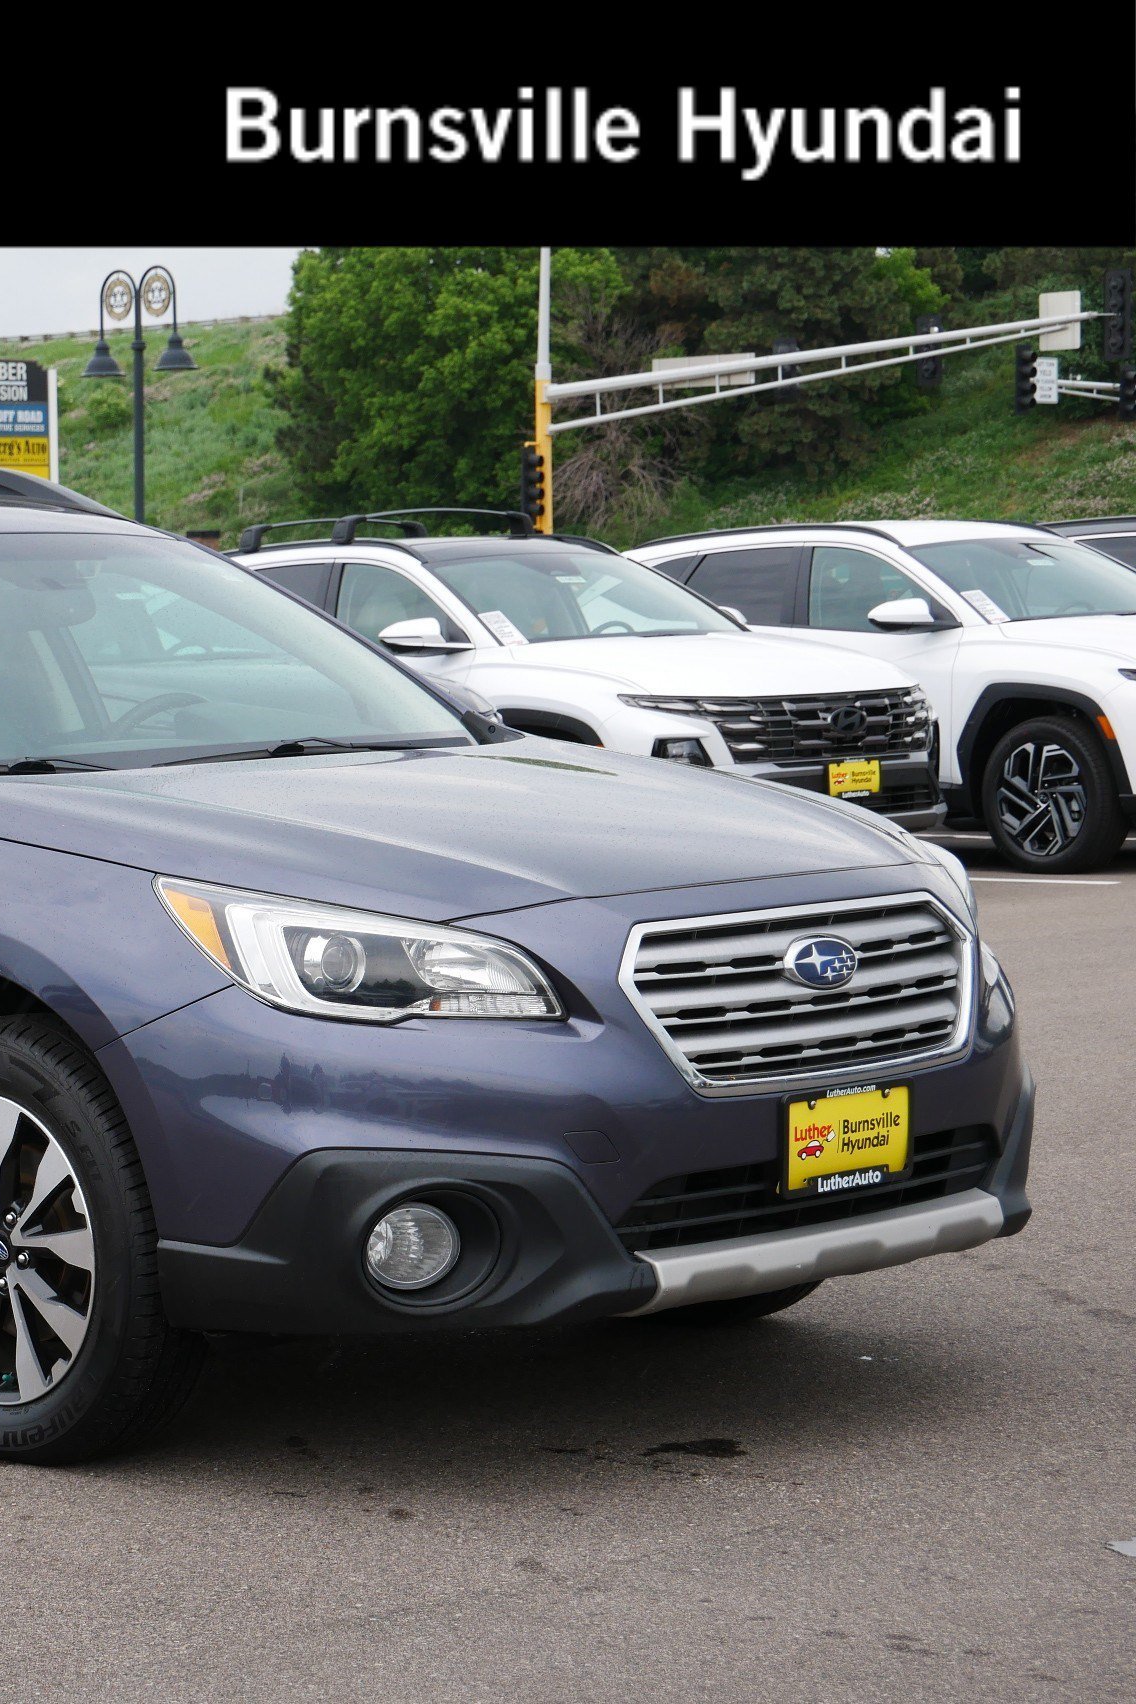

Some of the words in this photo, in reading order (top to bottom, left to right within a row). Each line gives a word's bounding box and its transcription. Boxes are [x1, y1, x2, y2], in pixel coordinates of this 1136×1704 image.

[826, 1084, 876, 1098] LutherAuto.com
[794, 1123, 832, 1143] Luther
[842, 1112, 901, 1135] Burnsville
[841, 1130, 890, 1155] Hyundai
[817, 1169, 882, 1193] LutherAuto
